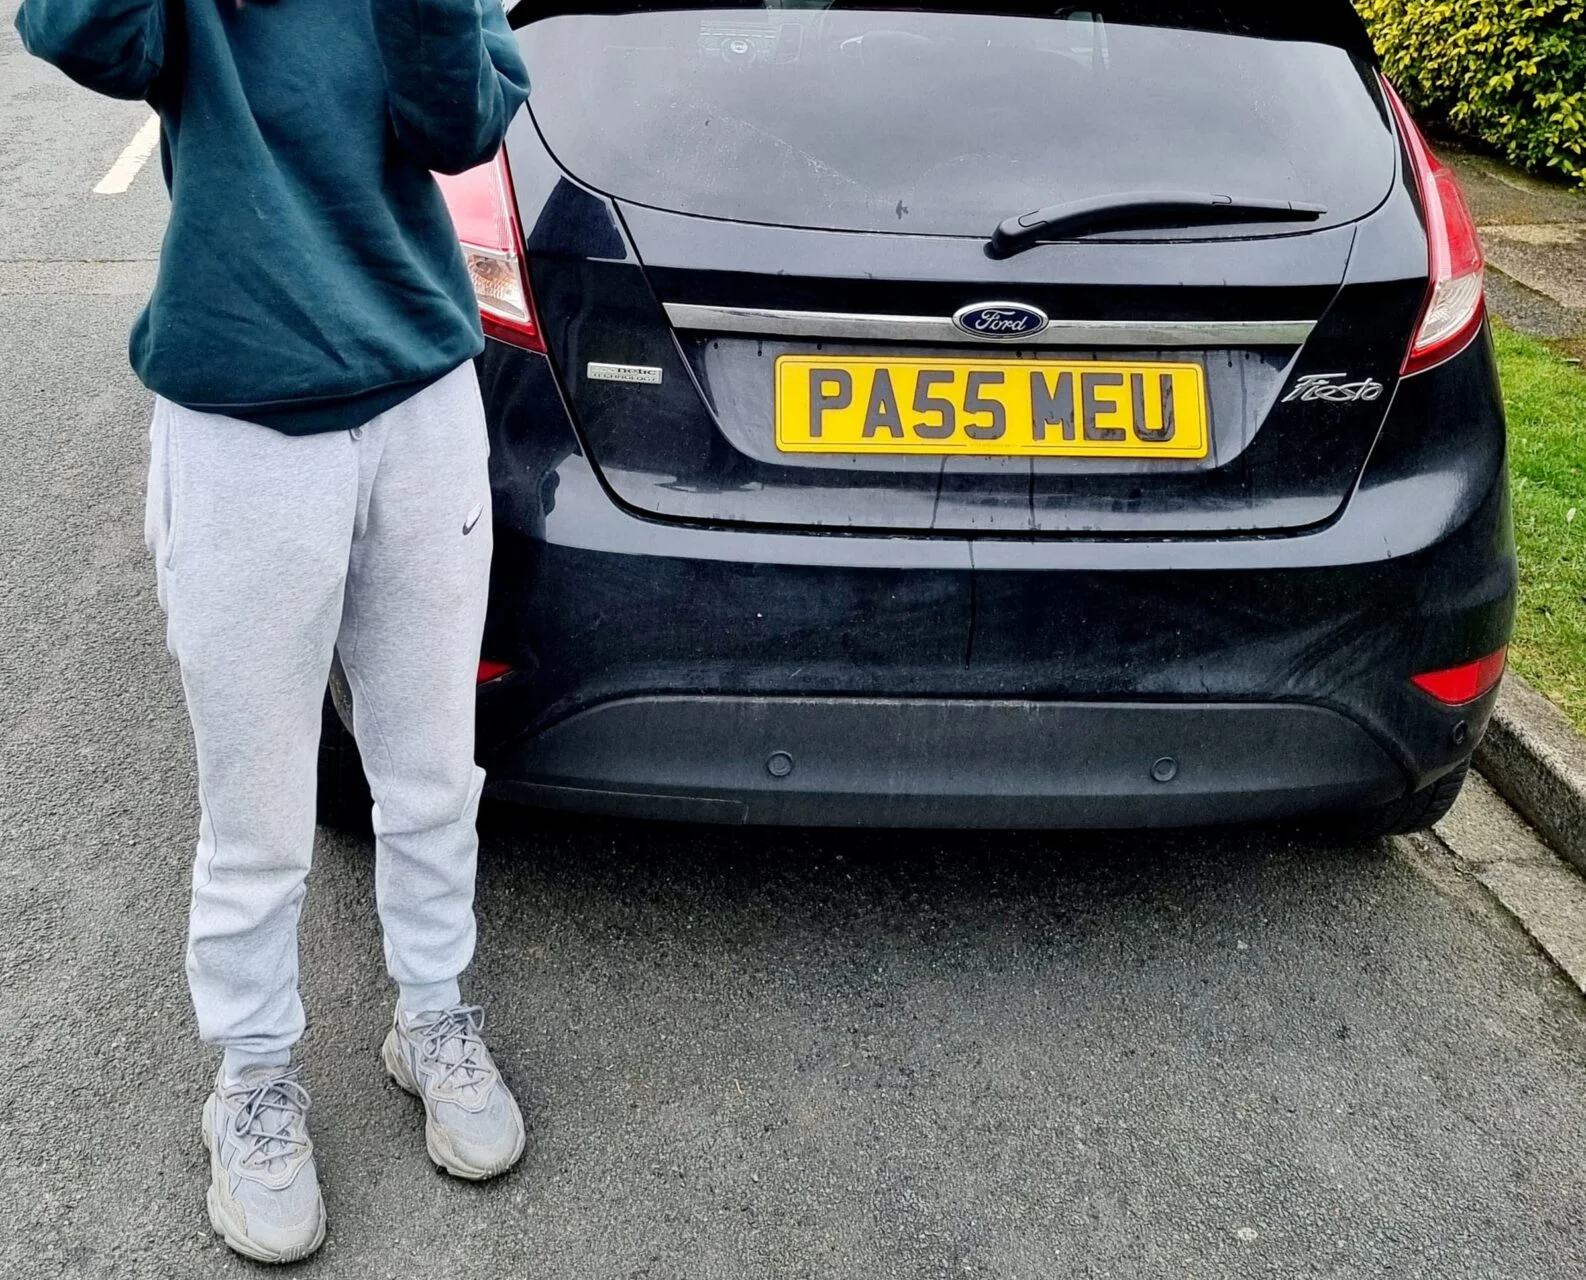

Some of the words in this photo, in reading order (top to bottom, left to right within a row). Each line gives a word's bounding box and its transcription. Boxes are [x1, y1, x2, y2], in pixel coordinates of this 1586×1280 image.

[975, 309, 1028, 331] Ford
[1281, 372, 1384, 403] Fiesta
[809, 368, 1007, 441] PA55
[1030, 371, 1177, 443] MEU
